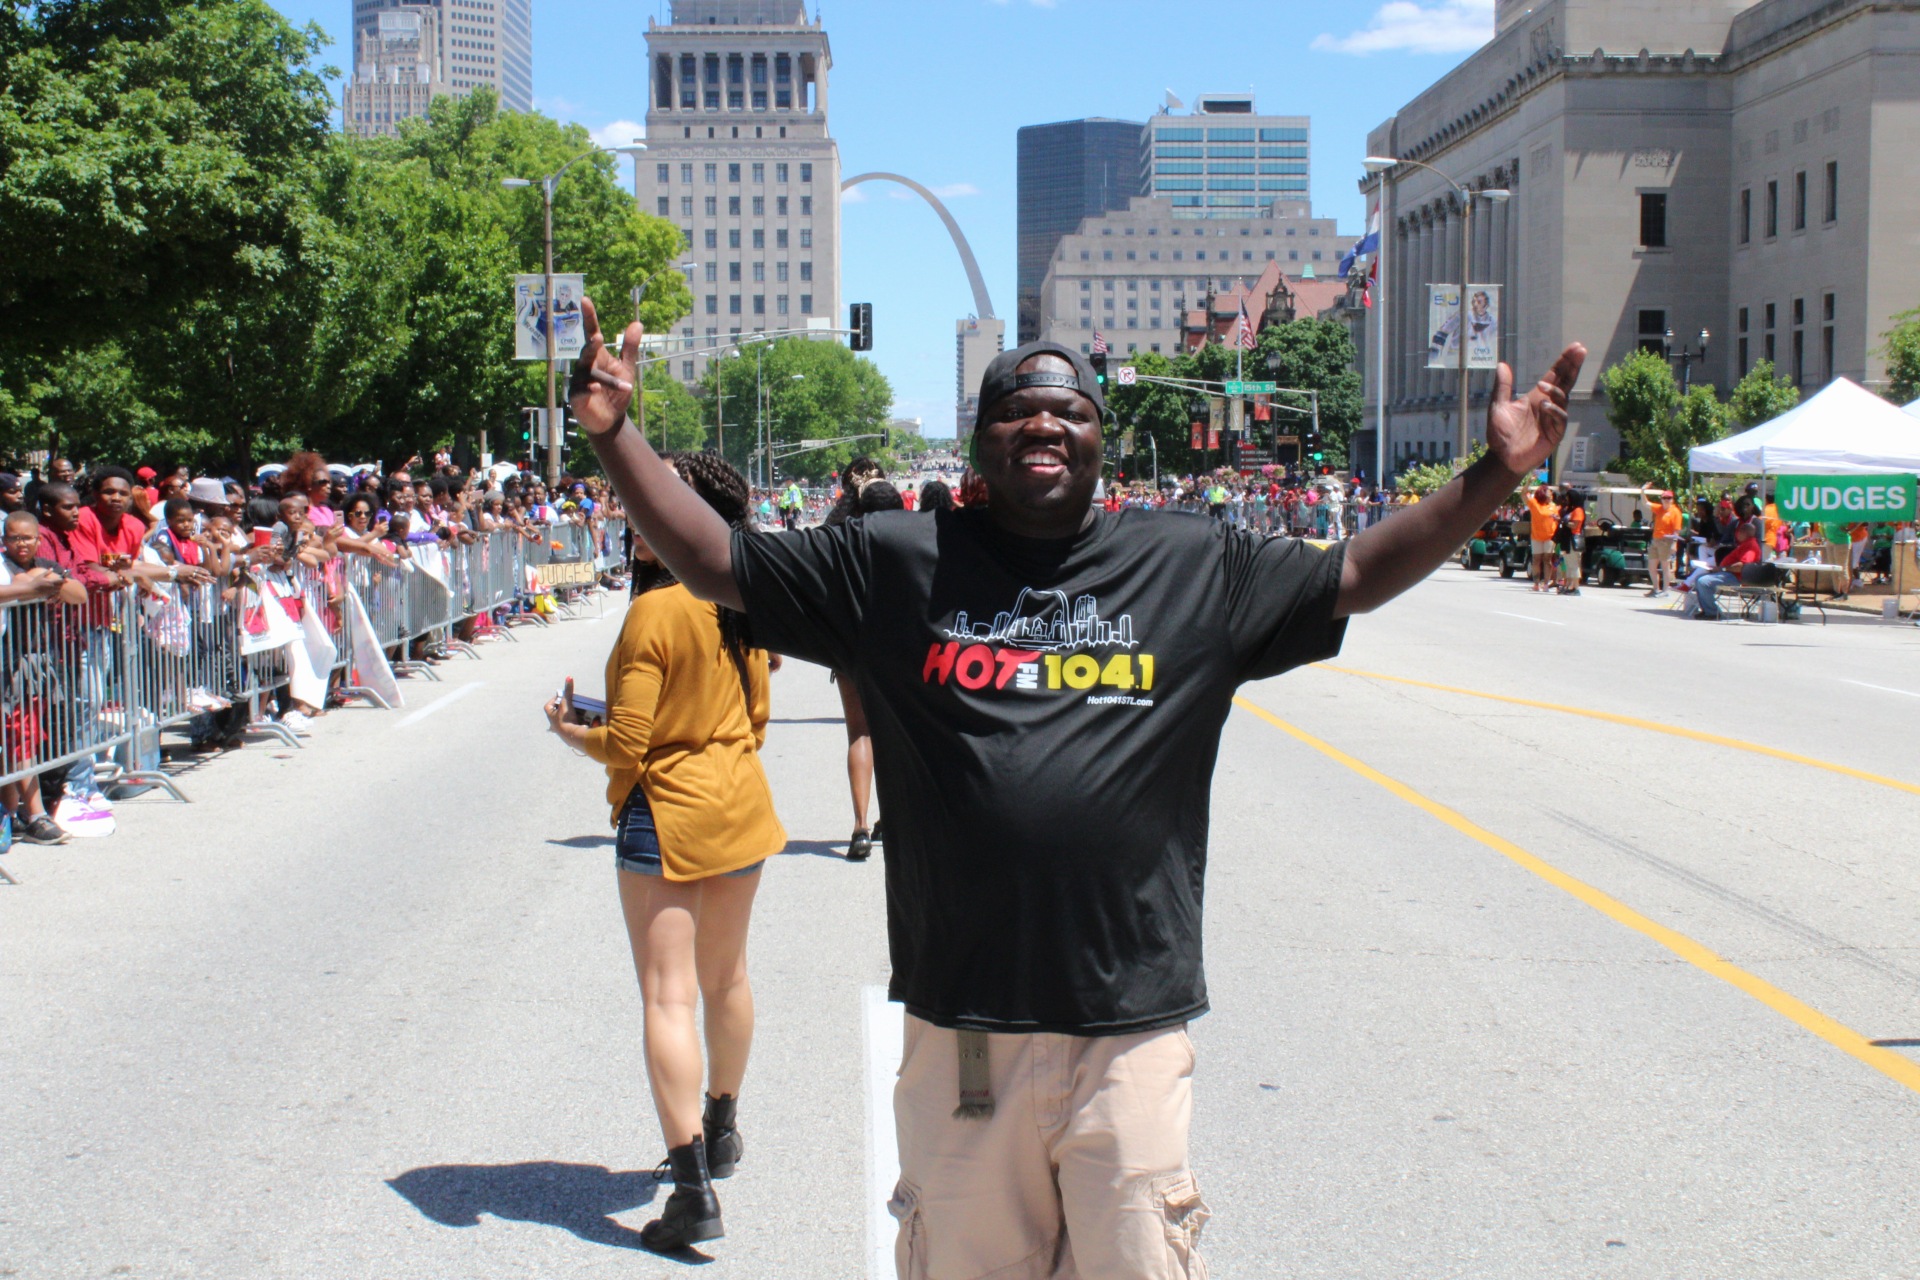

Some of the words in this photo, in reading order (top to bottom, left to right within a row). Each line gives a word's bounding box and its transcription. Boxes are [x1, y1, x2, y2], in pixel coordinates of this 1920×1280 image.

[1244, 384, 1262, 392] 15th
[1783, 486, 1906, 511] JUDGES
[537, 562, 593, 585] JUDGES
[923, 642, 1043, 690] HOT
[1016, 663, 1039, 689] FM
[1045, 654, 1154, 690] 104.1
[1087, 695, 1154, 707] Hot1041STL.com
